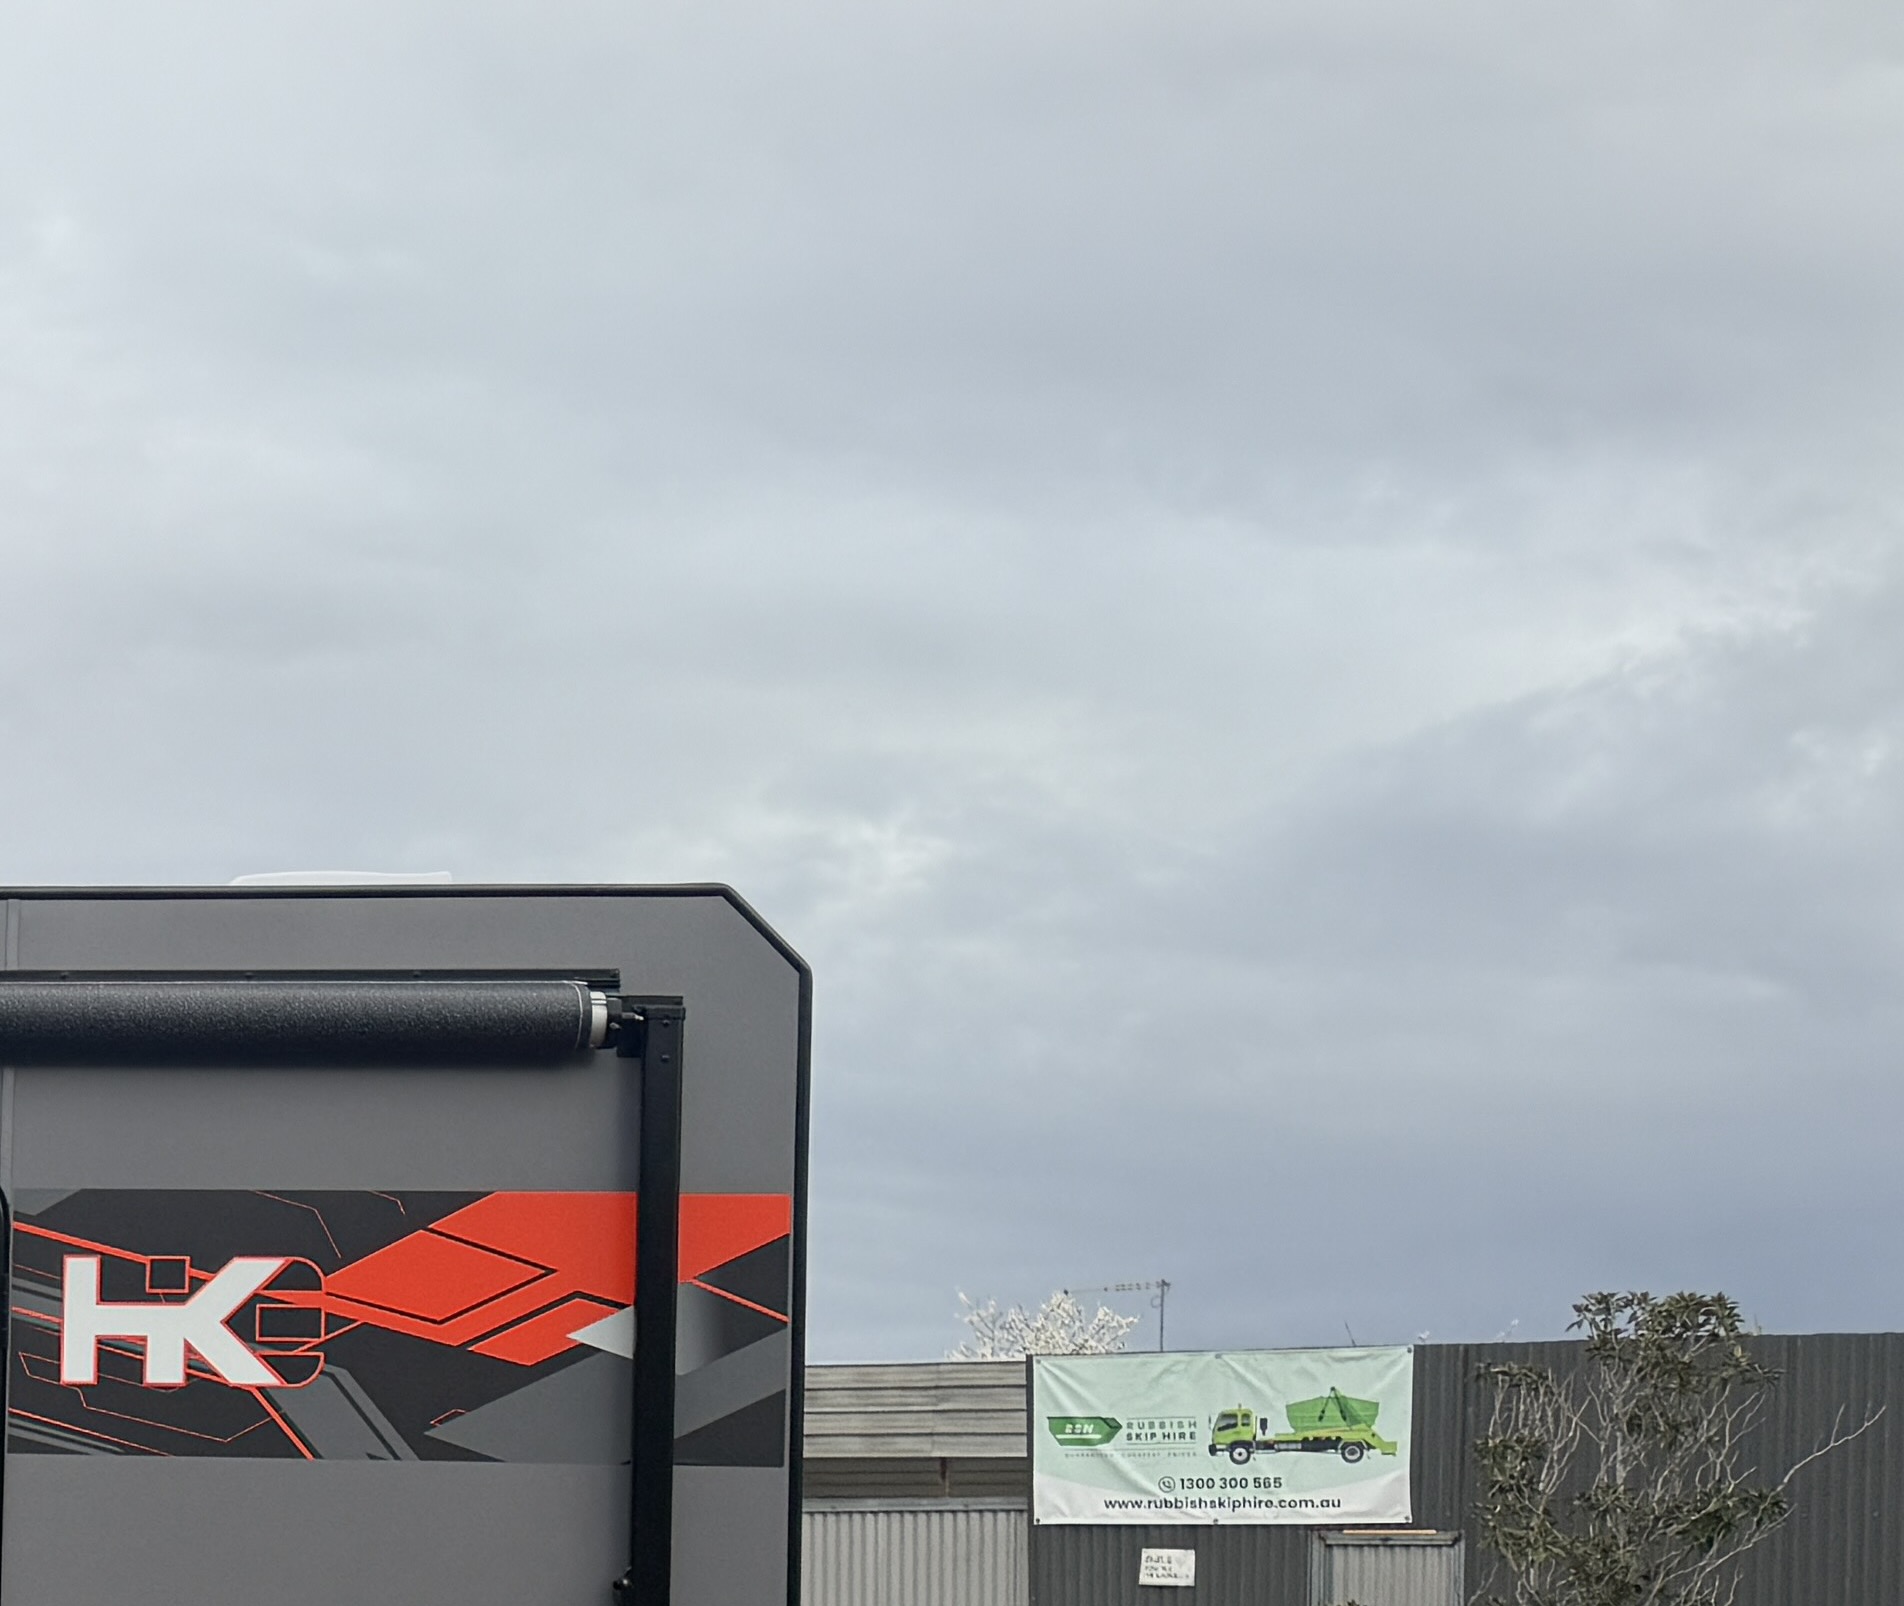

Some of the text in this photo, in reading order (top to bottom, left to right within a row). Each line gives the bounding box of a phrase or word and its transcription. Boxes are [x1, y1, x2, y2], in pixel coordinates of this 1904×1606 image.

[60, 1254, 296, 1388] HK
[1126, 1431, 1196, 1441] SKIP HIRE
[1180, 1476, 1282, 1490] 1300 300 565
[1103, 1496, 1341, 1513] www.rubbishskiphire.com.au
